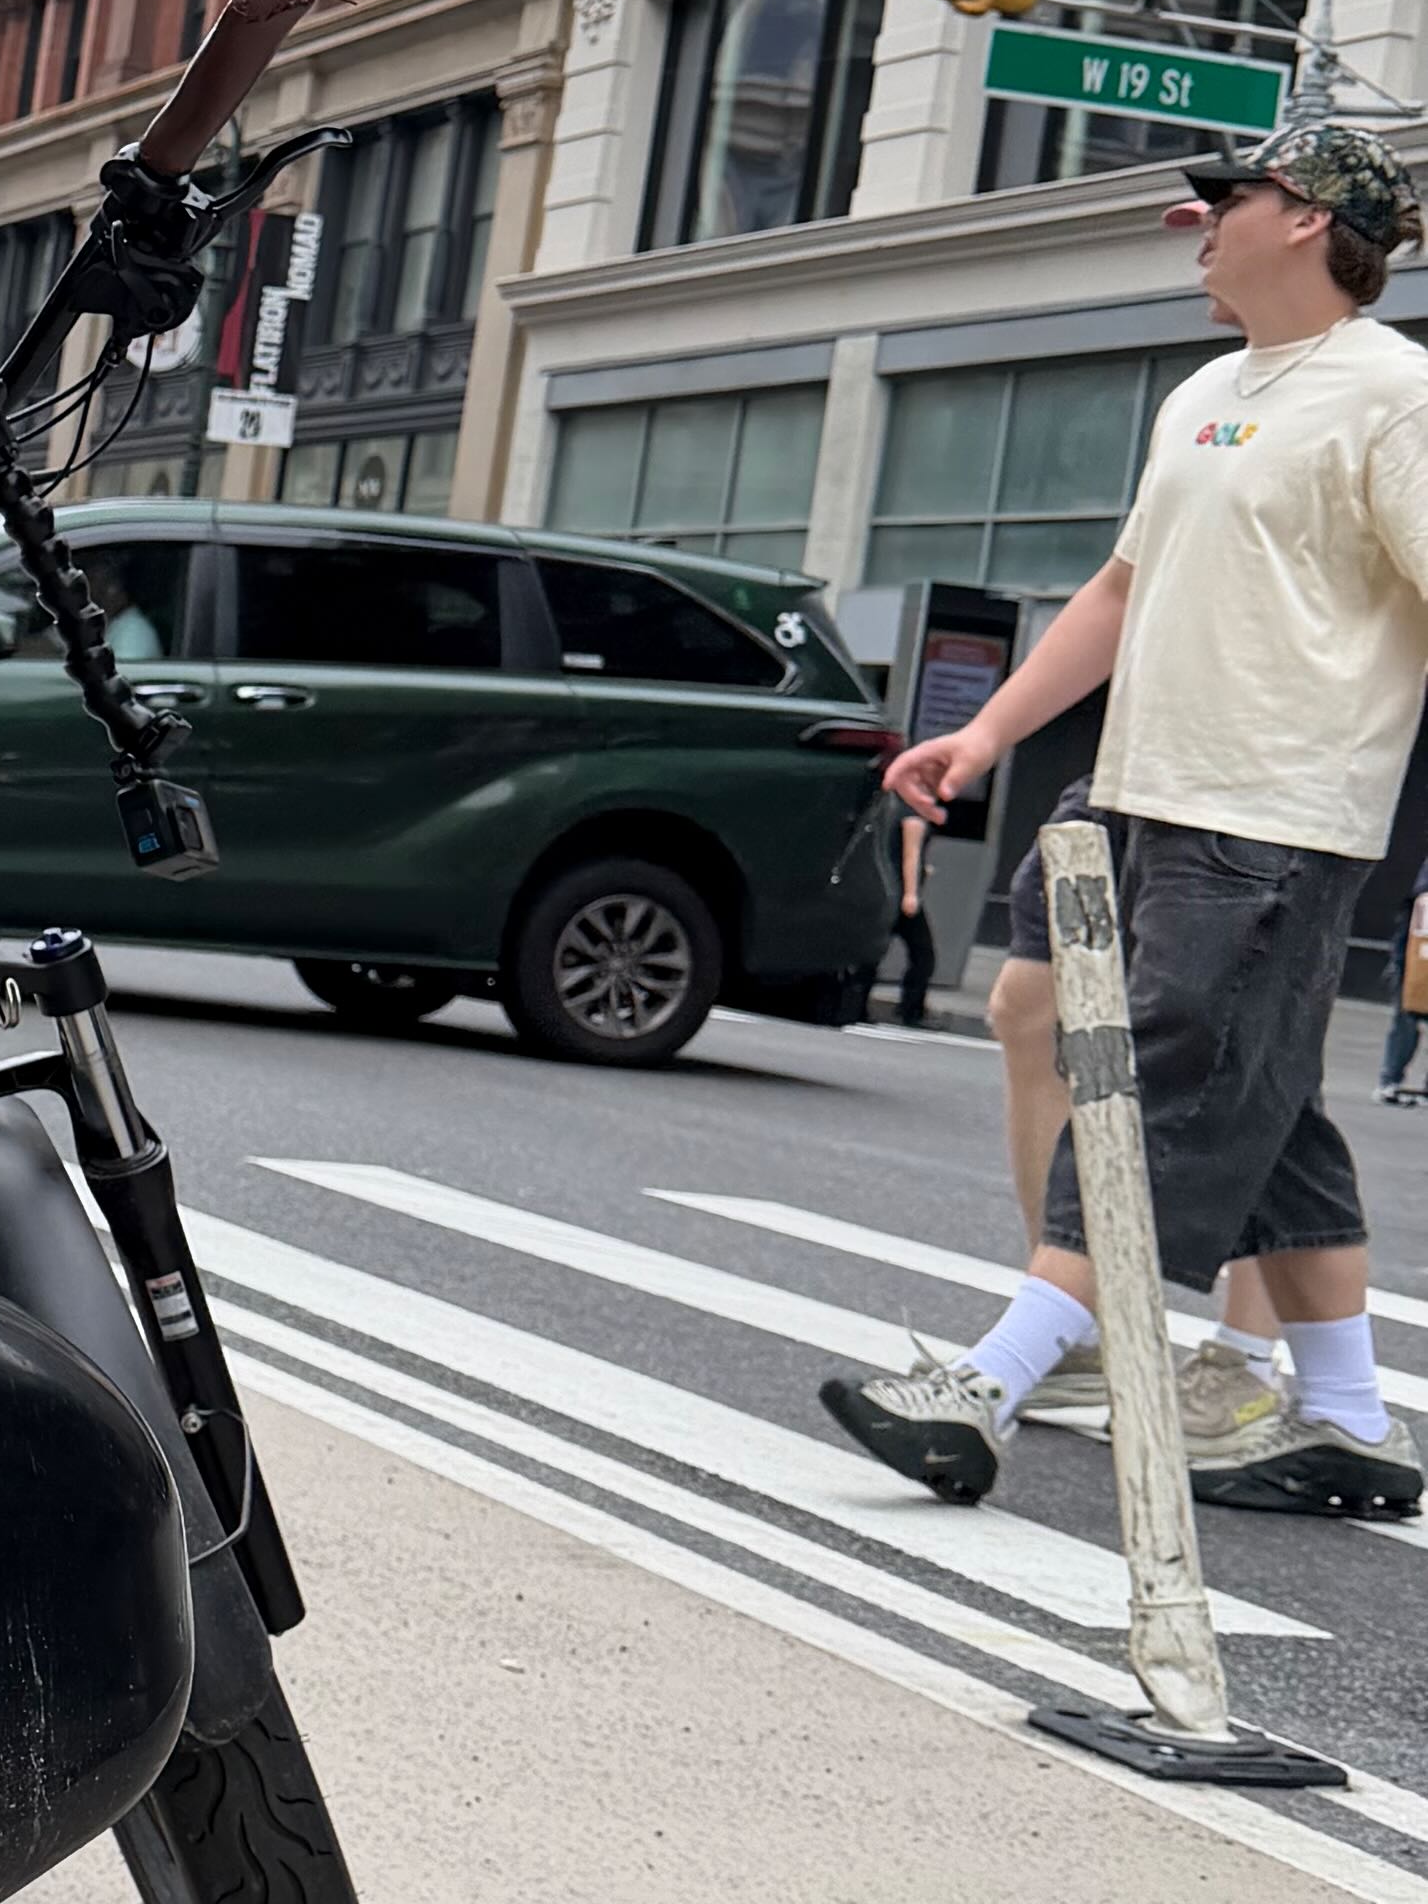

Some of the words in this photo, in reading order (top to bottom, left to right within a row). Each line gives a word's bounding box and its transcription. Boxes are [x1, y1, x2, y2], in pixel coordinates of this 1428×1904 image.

[1082, 56, 1110, 94] W
[1117, 61, 1150, 99] 19
[1158, 68, 1193, 108] St
[1196, 422, 1258, 446] GOLF
